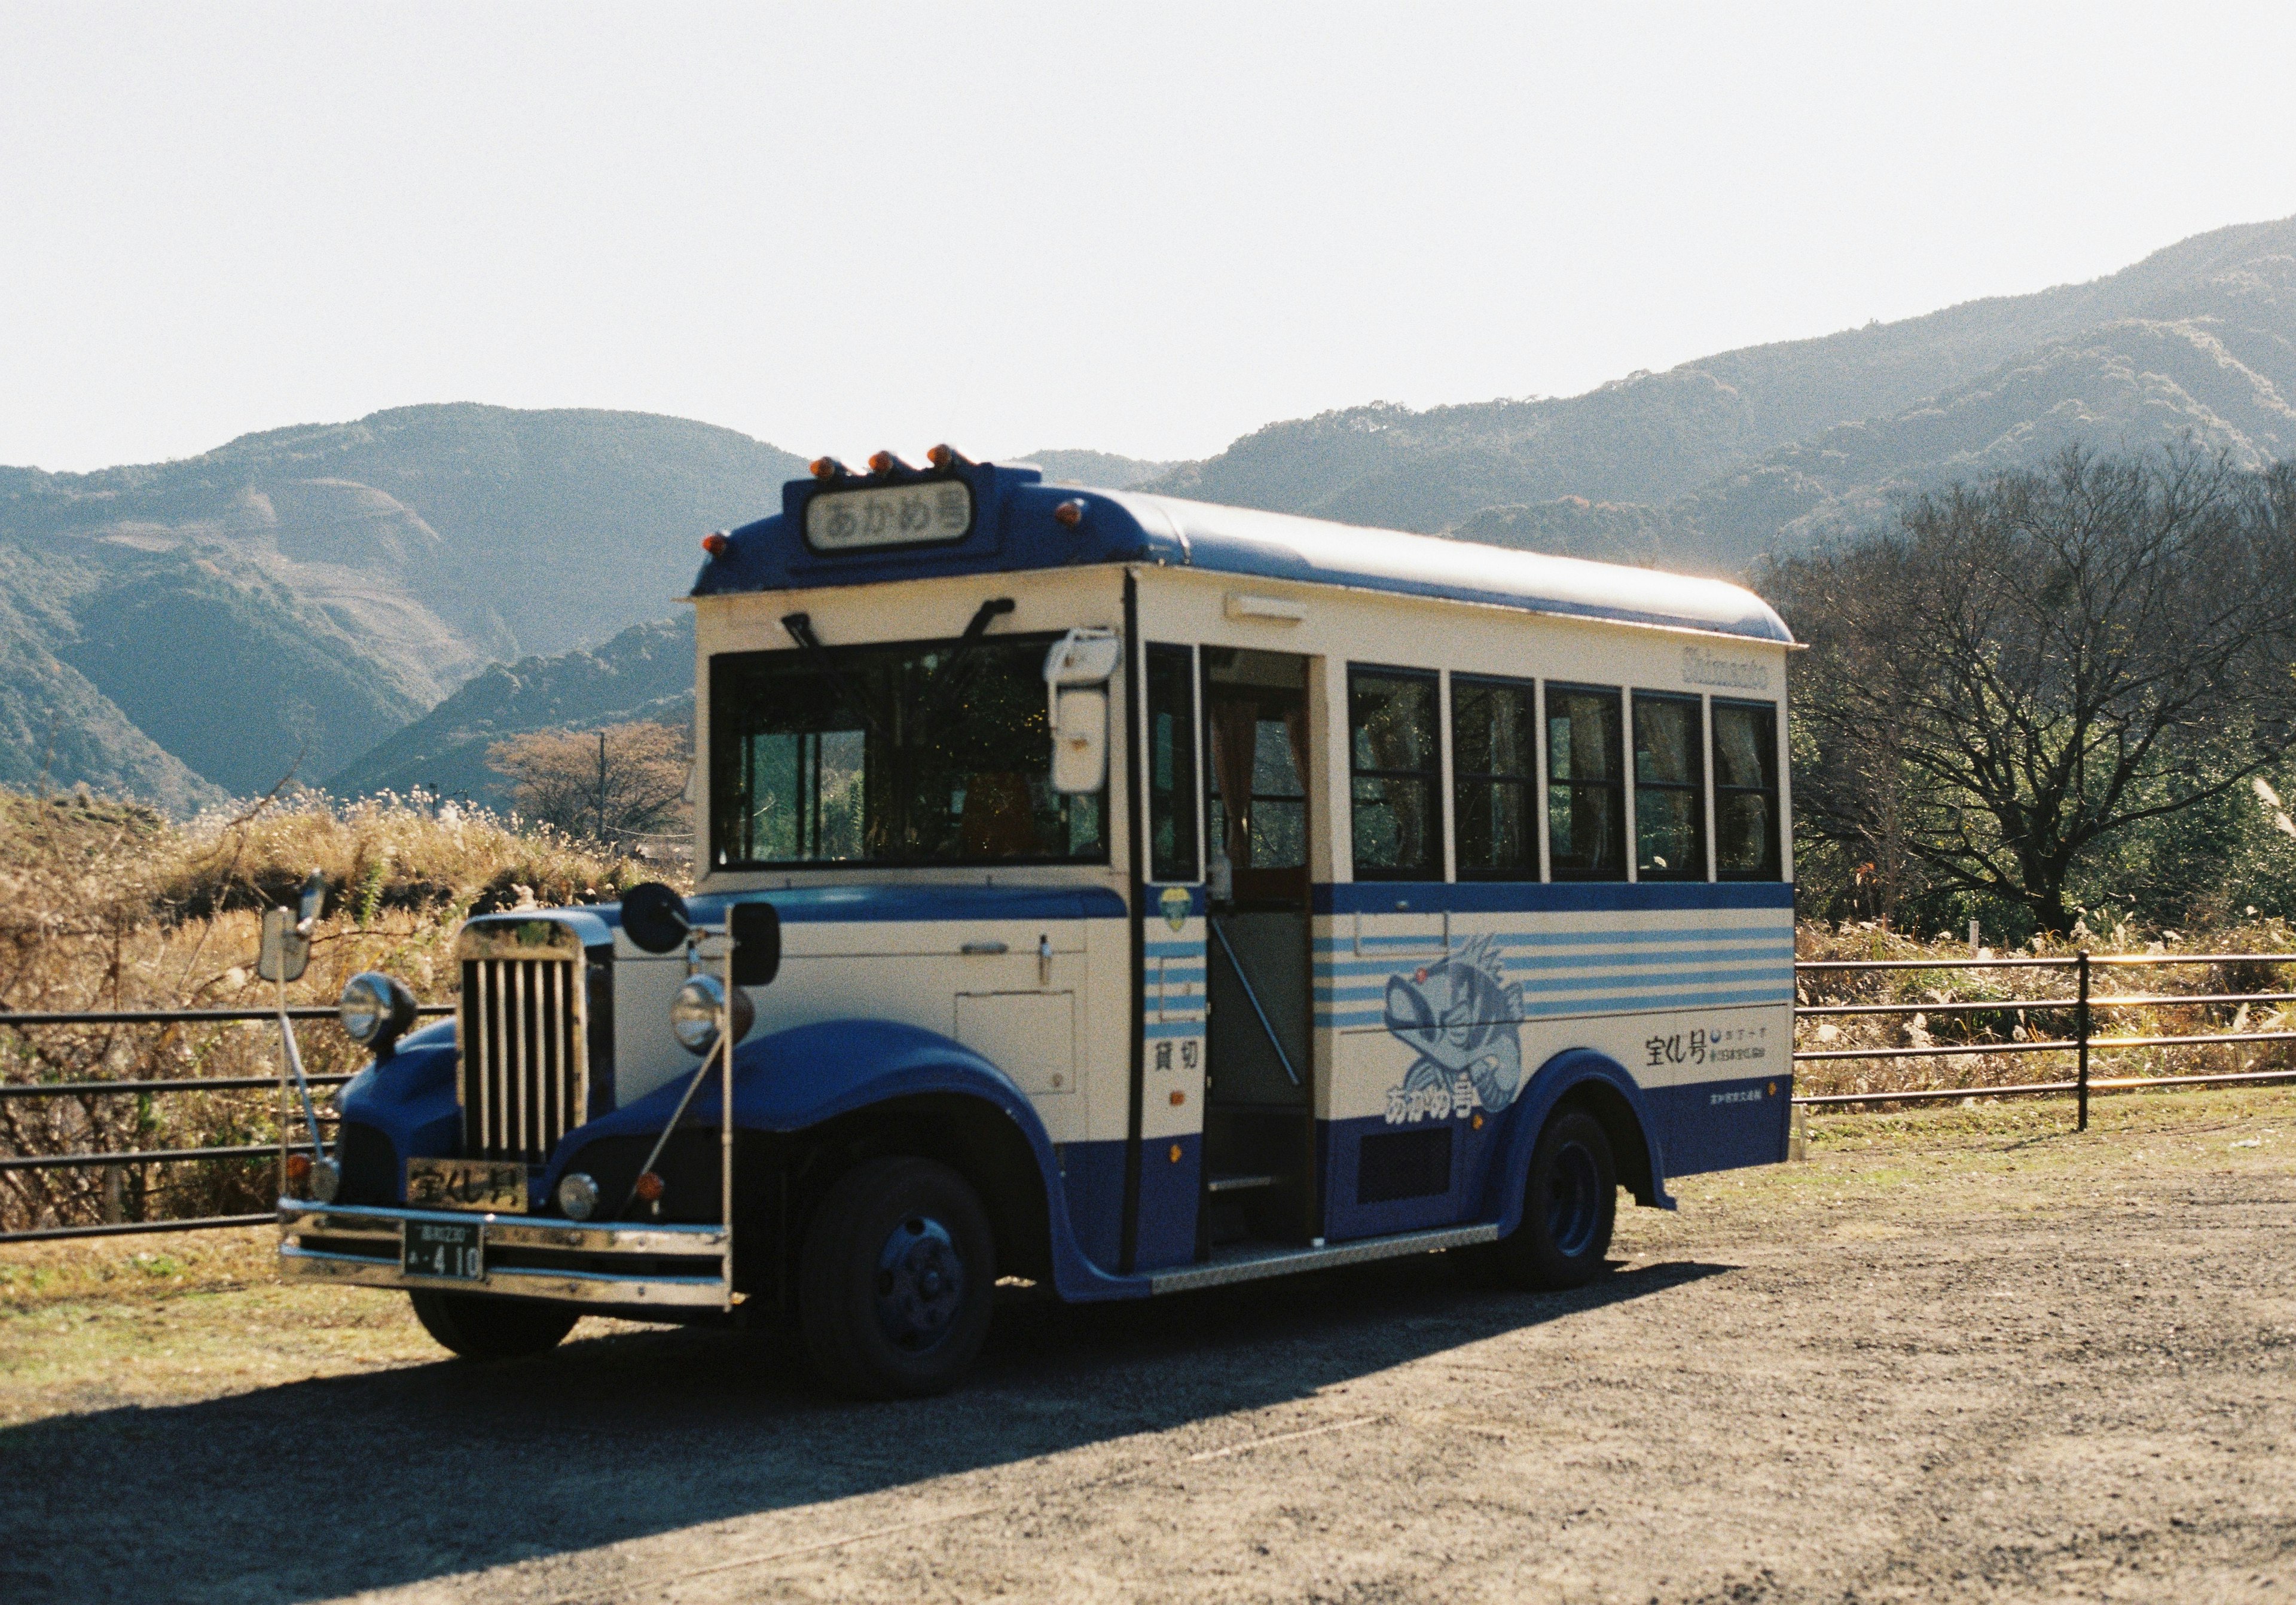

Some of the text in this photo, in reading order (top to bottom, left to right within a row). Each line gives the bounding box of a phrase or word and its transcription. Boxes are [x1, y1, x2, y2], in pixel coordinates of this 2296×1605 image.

[826, 490, 964, 538] あかめ号
[1385, 1072, 1472, 1124] あかめ号
